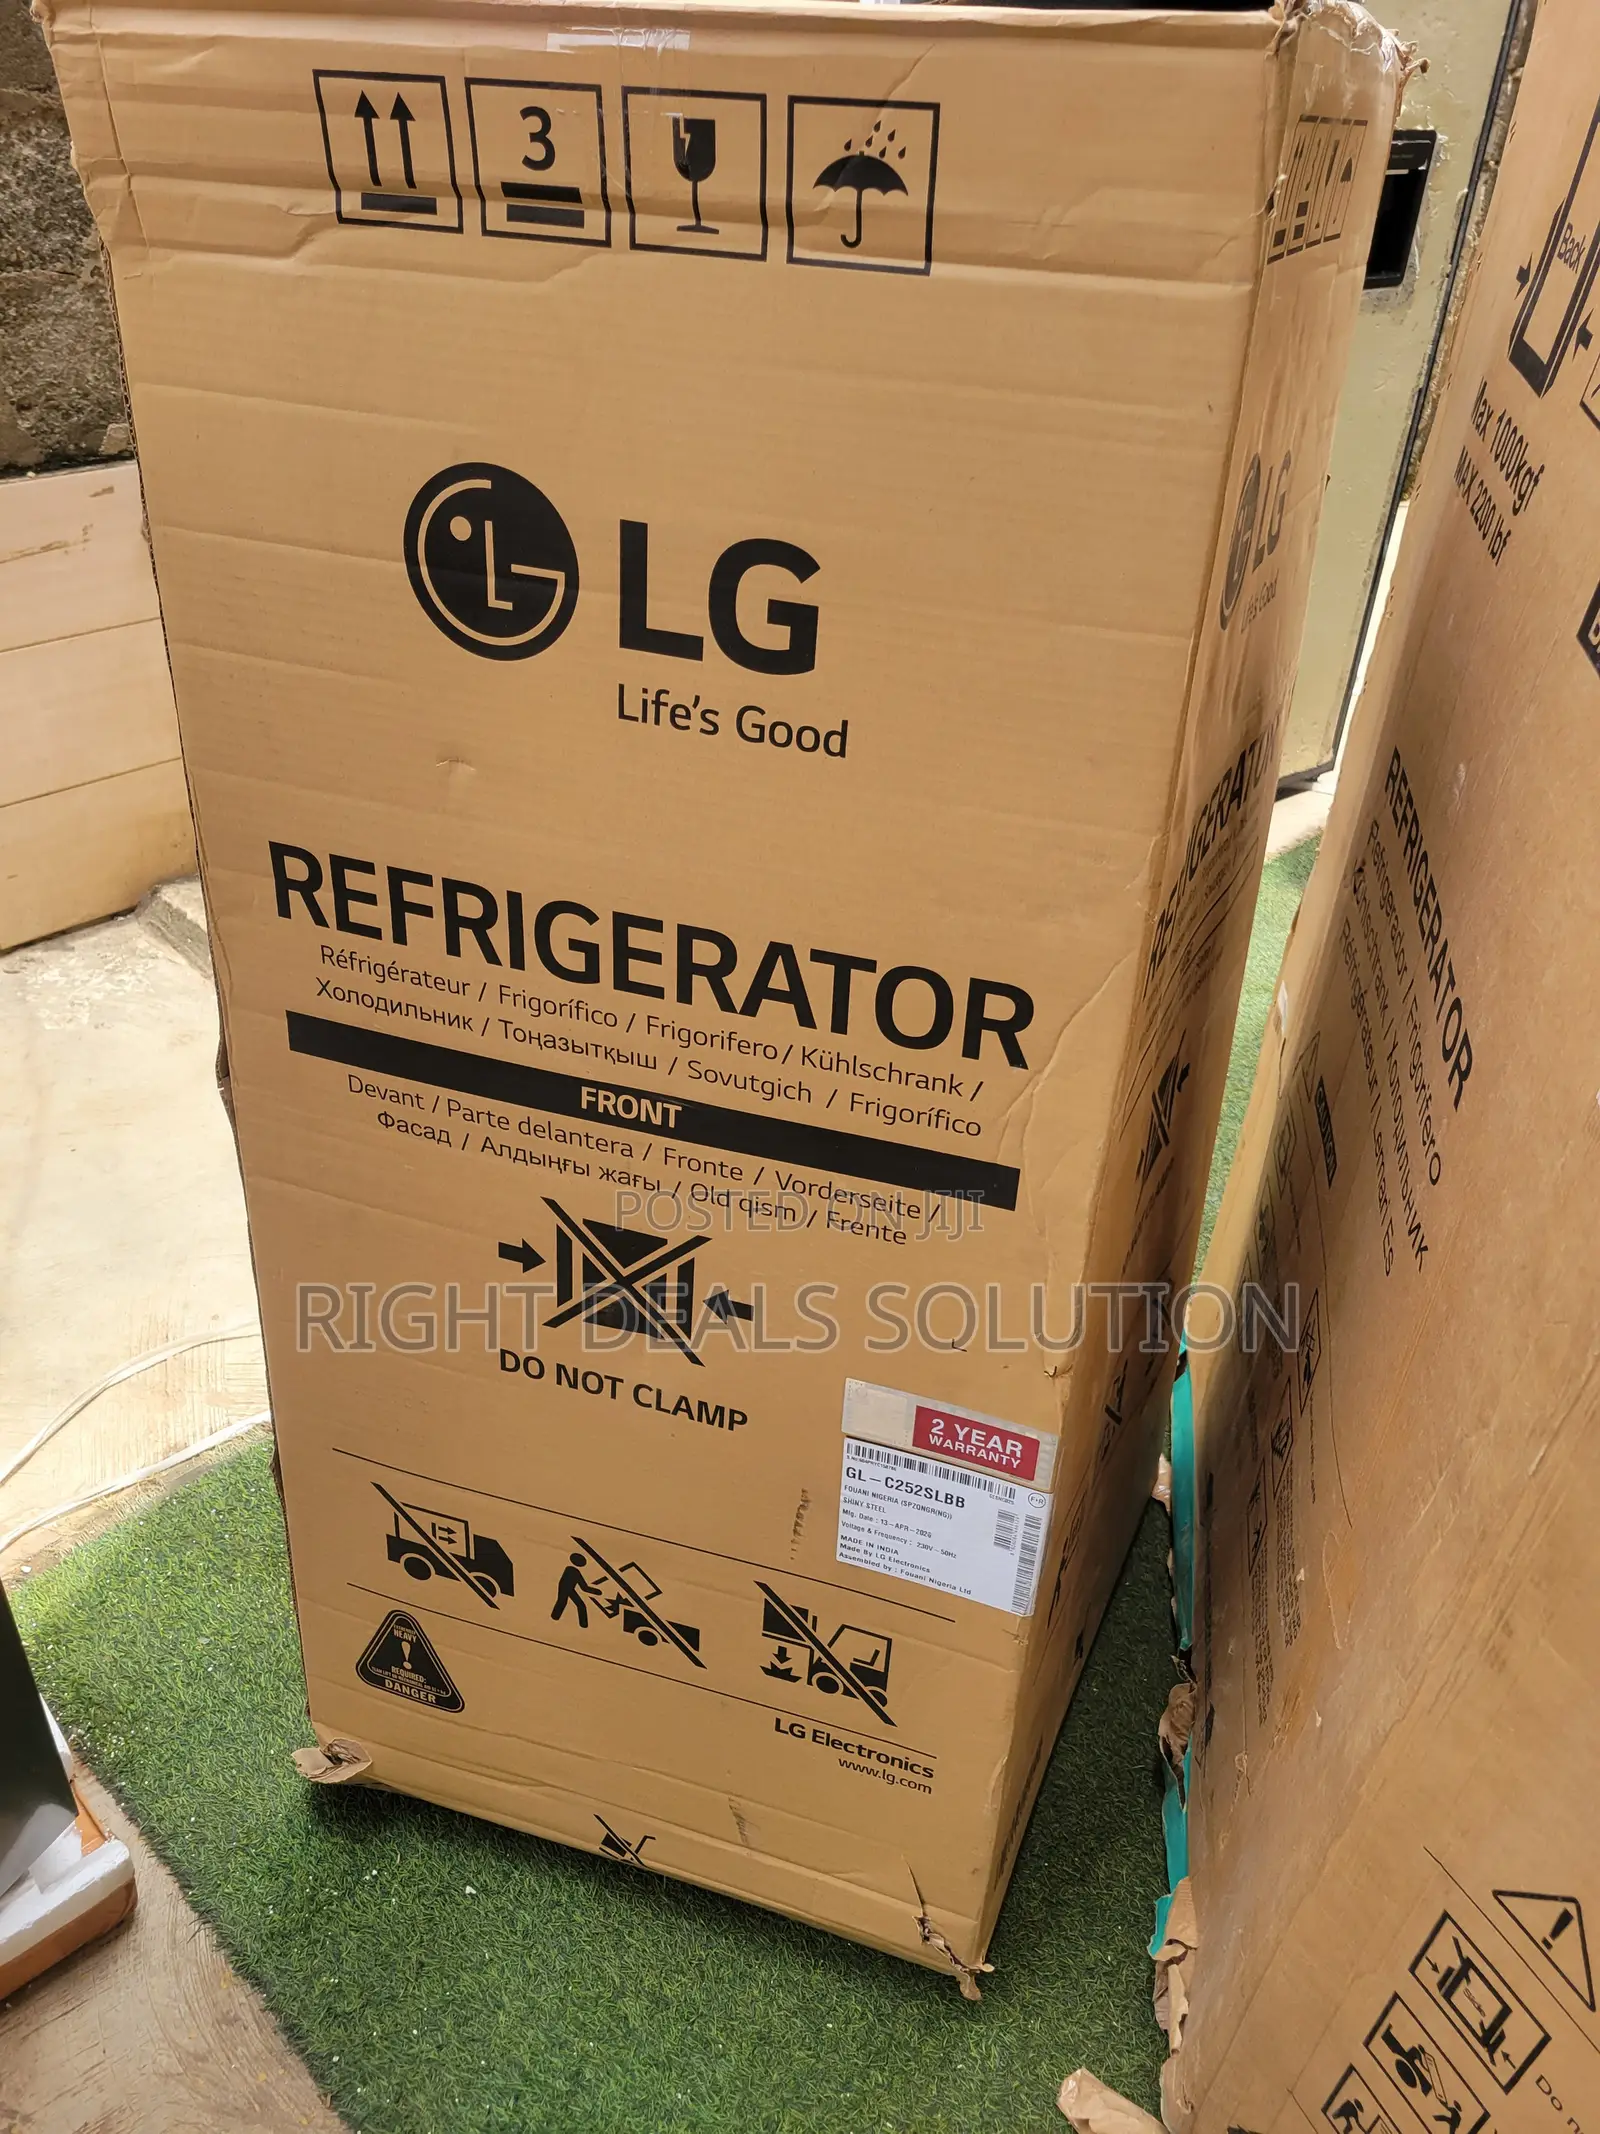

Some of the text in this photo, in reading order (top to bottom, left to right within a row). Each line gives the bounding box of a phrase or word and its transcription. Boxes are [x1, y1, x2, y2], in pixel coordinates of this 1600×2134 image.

[519, 105, 556, 171] 3
[1557, 222, 1586, 274] Back
[1471, 376, 1545, 517] Max 1000kgf
[1252, 449, 1291, 574] LG
[1454, 445, 1511, 567] MAX 2200 lbf
[619, 518, 821, 676] LG
[735, 704, 848, 758] Good
[1385, 744, 1472, 1112] REFRIGERATOR
[268, 840, 1034, 1070] REFRIGERATOR
[320, 945, 471, 996] Réfrigérateur
[478, 982, 487, 1002] /
[499, 984, 618, 1027] Frigorífico
[626, 1013, 636, 1033] /
[801, 1045, 964, 1098] Kühlschrank
[969, 1080, 984, 1102] /
[1367, 819, 1407, 985] Refrigerador
[1406, 995, 1441, 1186] Frigorifero
[316, 977, 982, 1137] Холодильник / Тоңазытқыш / Sovutgich / Frigorífico
[581, 1086, 682, 1129] FRONT
[347, 1074, 942, 1223] Devant / Parte delantera / Fronte / Vorderseite /
[377, 1111, 452, 1148] Фасад
[461, 1133, 469, 1151] /
[480, 1135, 590, 1177] Алдыңғы
[672, 1181, 682, 1200] /
[691, 1182, 730, 1208] Old
[738, 1196, 796, 1223] qism
[806, 1210, 818, 1229] /
[826, 1210, 907, 1245] Frente
[499, 1348, 748, 1432] DO NOT CLAMP
[929, 1434, 1021, 1469] WARRANTY
[930, 1418, 1023, 1458] 2 YEAR
[843, 1496, 887, 1514] SHINY STEEL
[844, 1484, 870, 1497] FOUANI
[871, 1492, 899, 1505] NIGERIA
[859, 1513, 874, 1522] Date
[840, 1534, 899, 1556] MADE IN INDIA
[840, 1542, 931, 1573] Made By LG Electronics
[841, 1521, 865, 1533] Voltage
[874, 1529, 907, 1545] Frequency
[839, 1552, 881, 1568] Assembled
[883, 1564, 892, 1572] by
[900, 1568, 927, 1581] Fouani
[928, 1577, 957, 1591] Nigeria
[959, 1587, 972, 1596] Ltd
[393, 1629, 418, 1643] HEAVY
[384, 1679, 437, 1704] DANGER
[391, 1665, 427, 1684] REQUIRED:
[774, 1717, 934, 1779] LG Electronics
[838, 1758, 932, 1795] www.lg.com
[1535, 2074, 1563, 2111] Do
